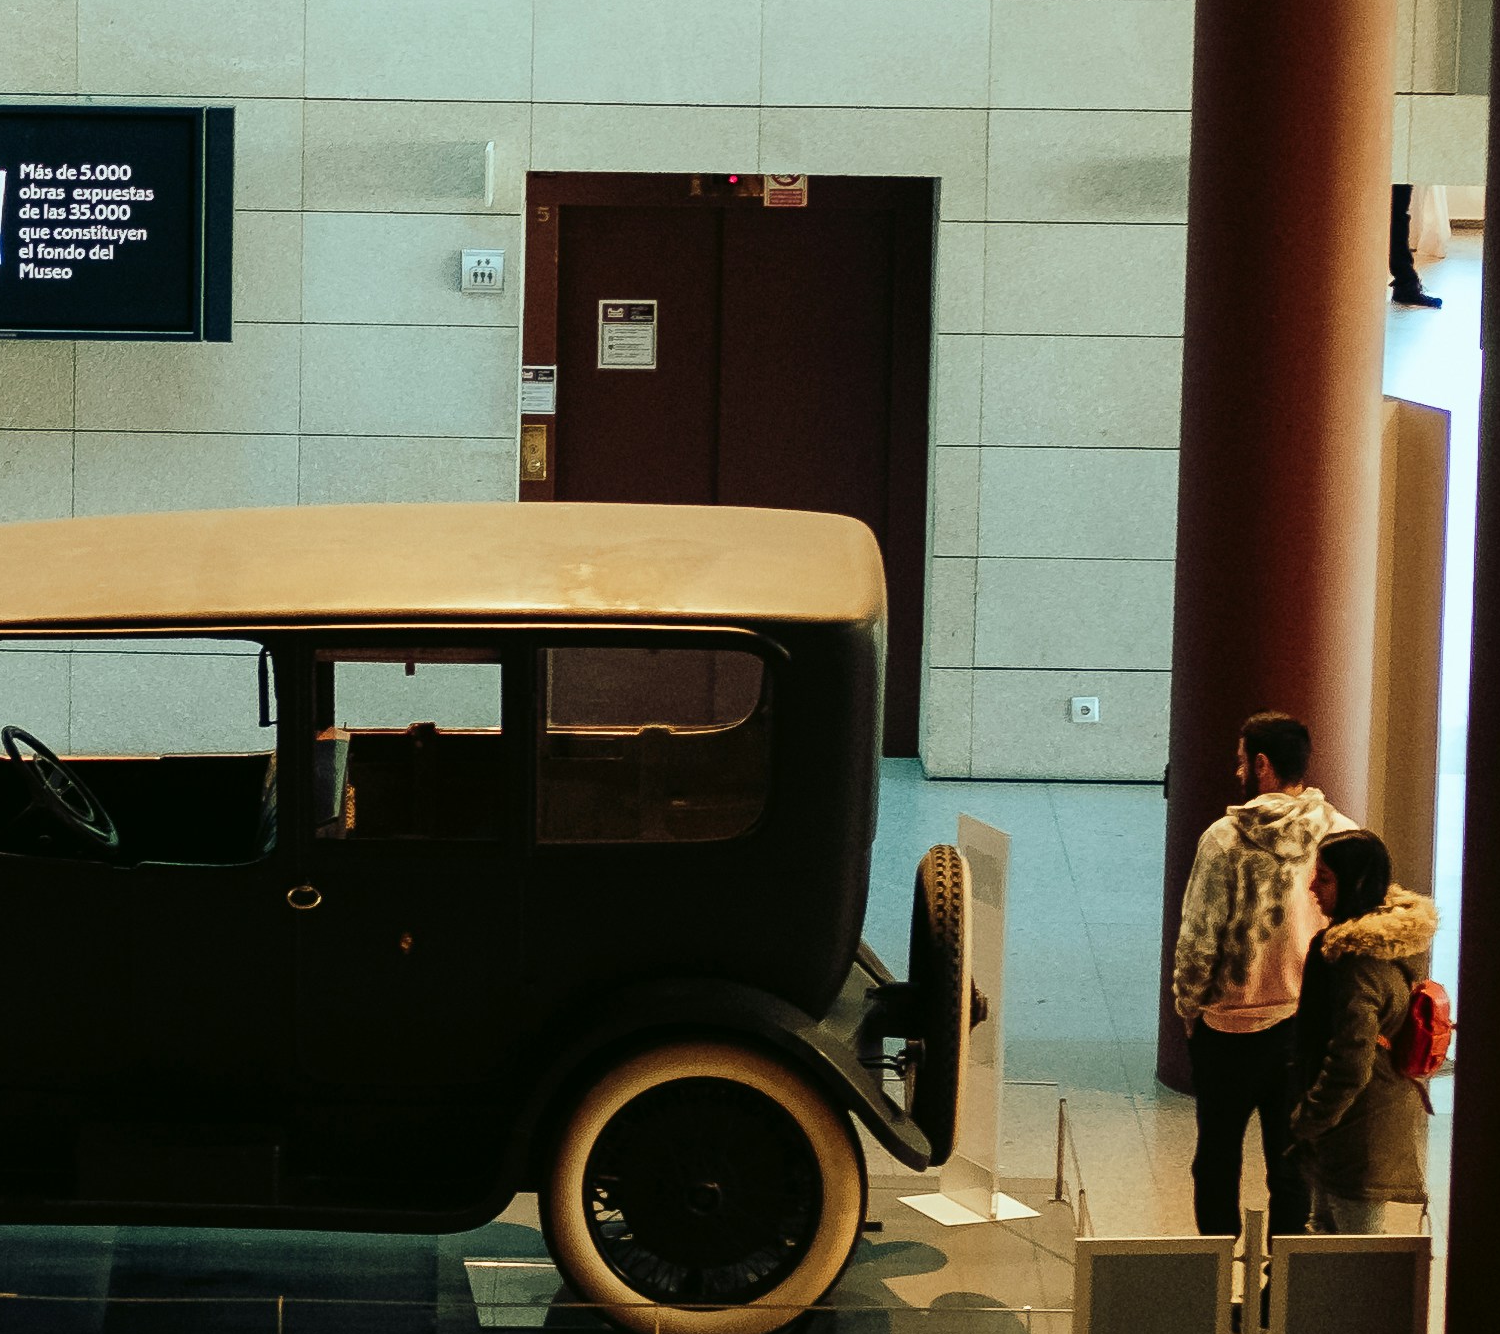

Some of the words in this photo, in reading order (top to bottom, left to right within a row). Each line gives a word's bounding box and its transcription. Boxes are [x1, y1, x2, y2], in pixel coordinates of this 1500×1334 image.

[20, 163, 53, 179] Más
[56, 164, 77, 179] de
[80, 165, 131, 180] 5.000
[19, 184, 65, 200] obras
[73, 185, 154, 203] expuestas
[19, 204, 40, 219] de
[43, 204, 66, 219] las
[69, 205, 131, 220] 35.000
[19, 226, 49, 242] que
[53, 225, 147, 243] constituyen
[19, 244, 33, 259] el
[37, 244, 86, 259] fondo
[89, 244, 114, 260] del
[19, 263, 72, 279] Museo
